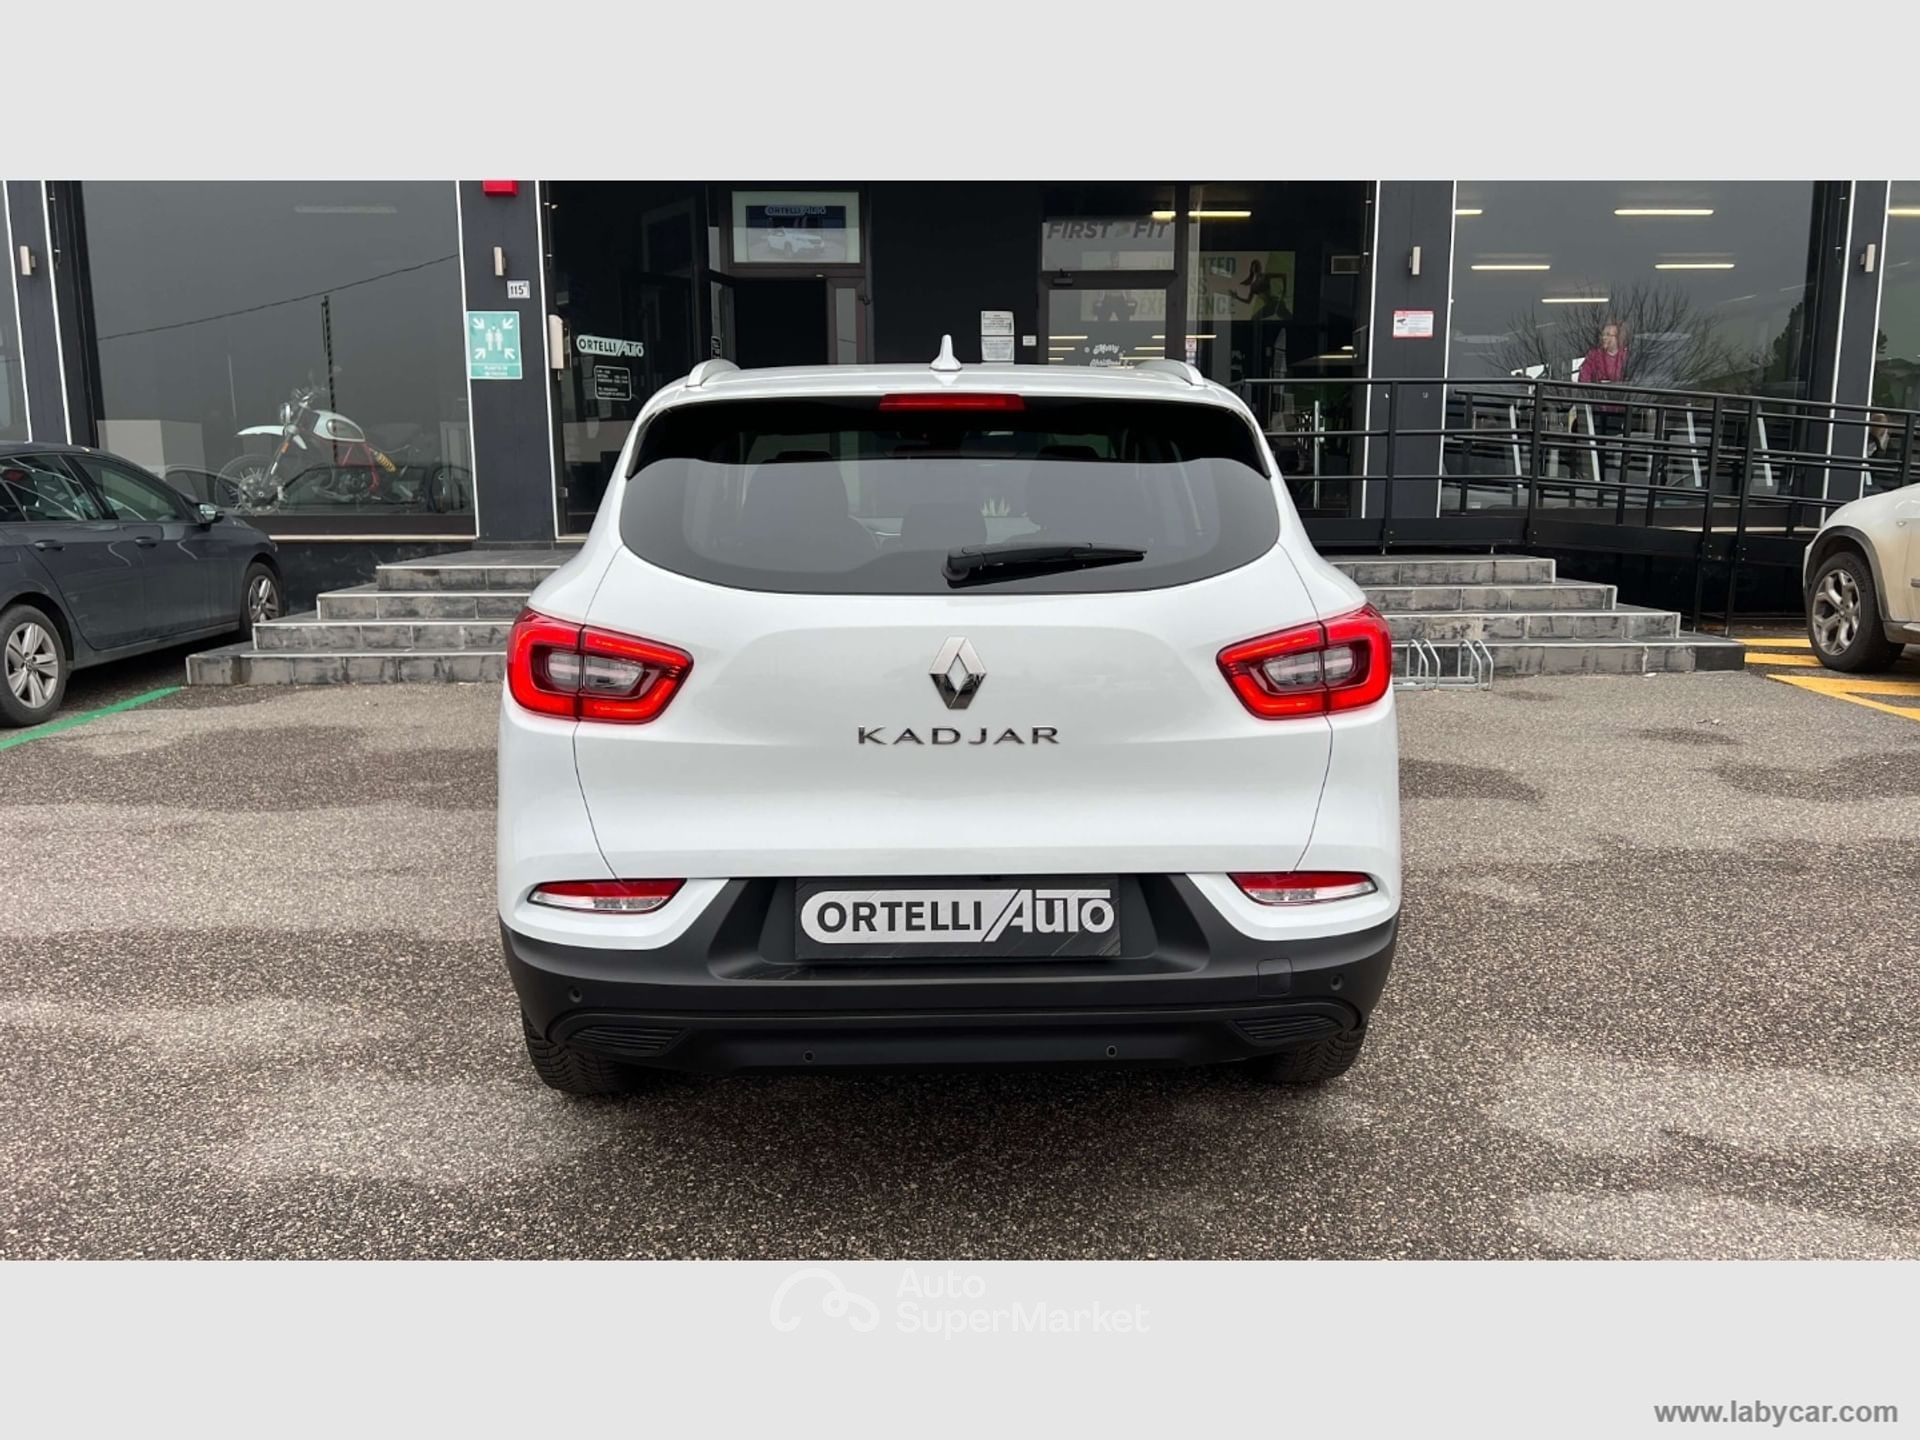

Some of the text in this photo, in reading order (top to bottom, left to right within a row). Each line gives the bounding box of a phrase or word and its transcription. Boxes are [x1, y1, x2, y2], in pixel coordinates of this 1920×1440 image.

[1046, 221, 1172, 239] FIRST FIT
[578, 338, 616, 353] ORTELLI
[857, 726, 1061, 745] KADJAR
[816, 900, 983, 933] ORTELLI
